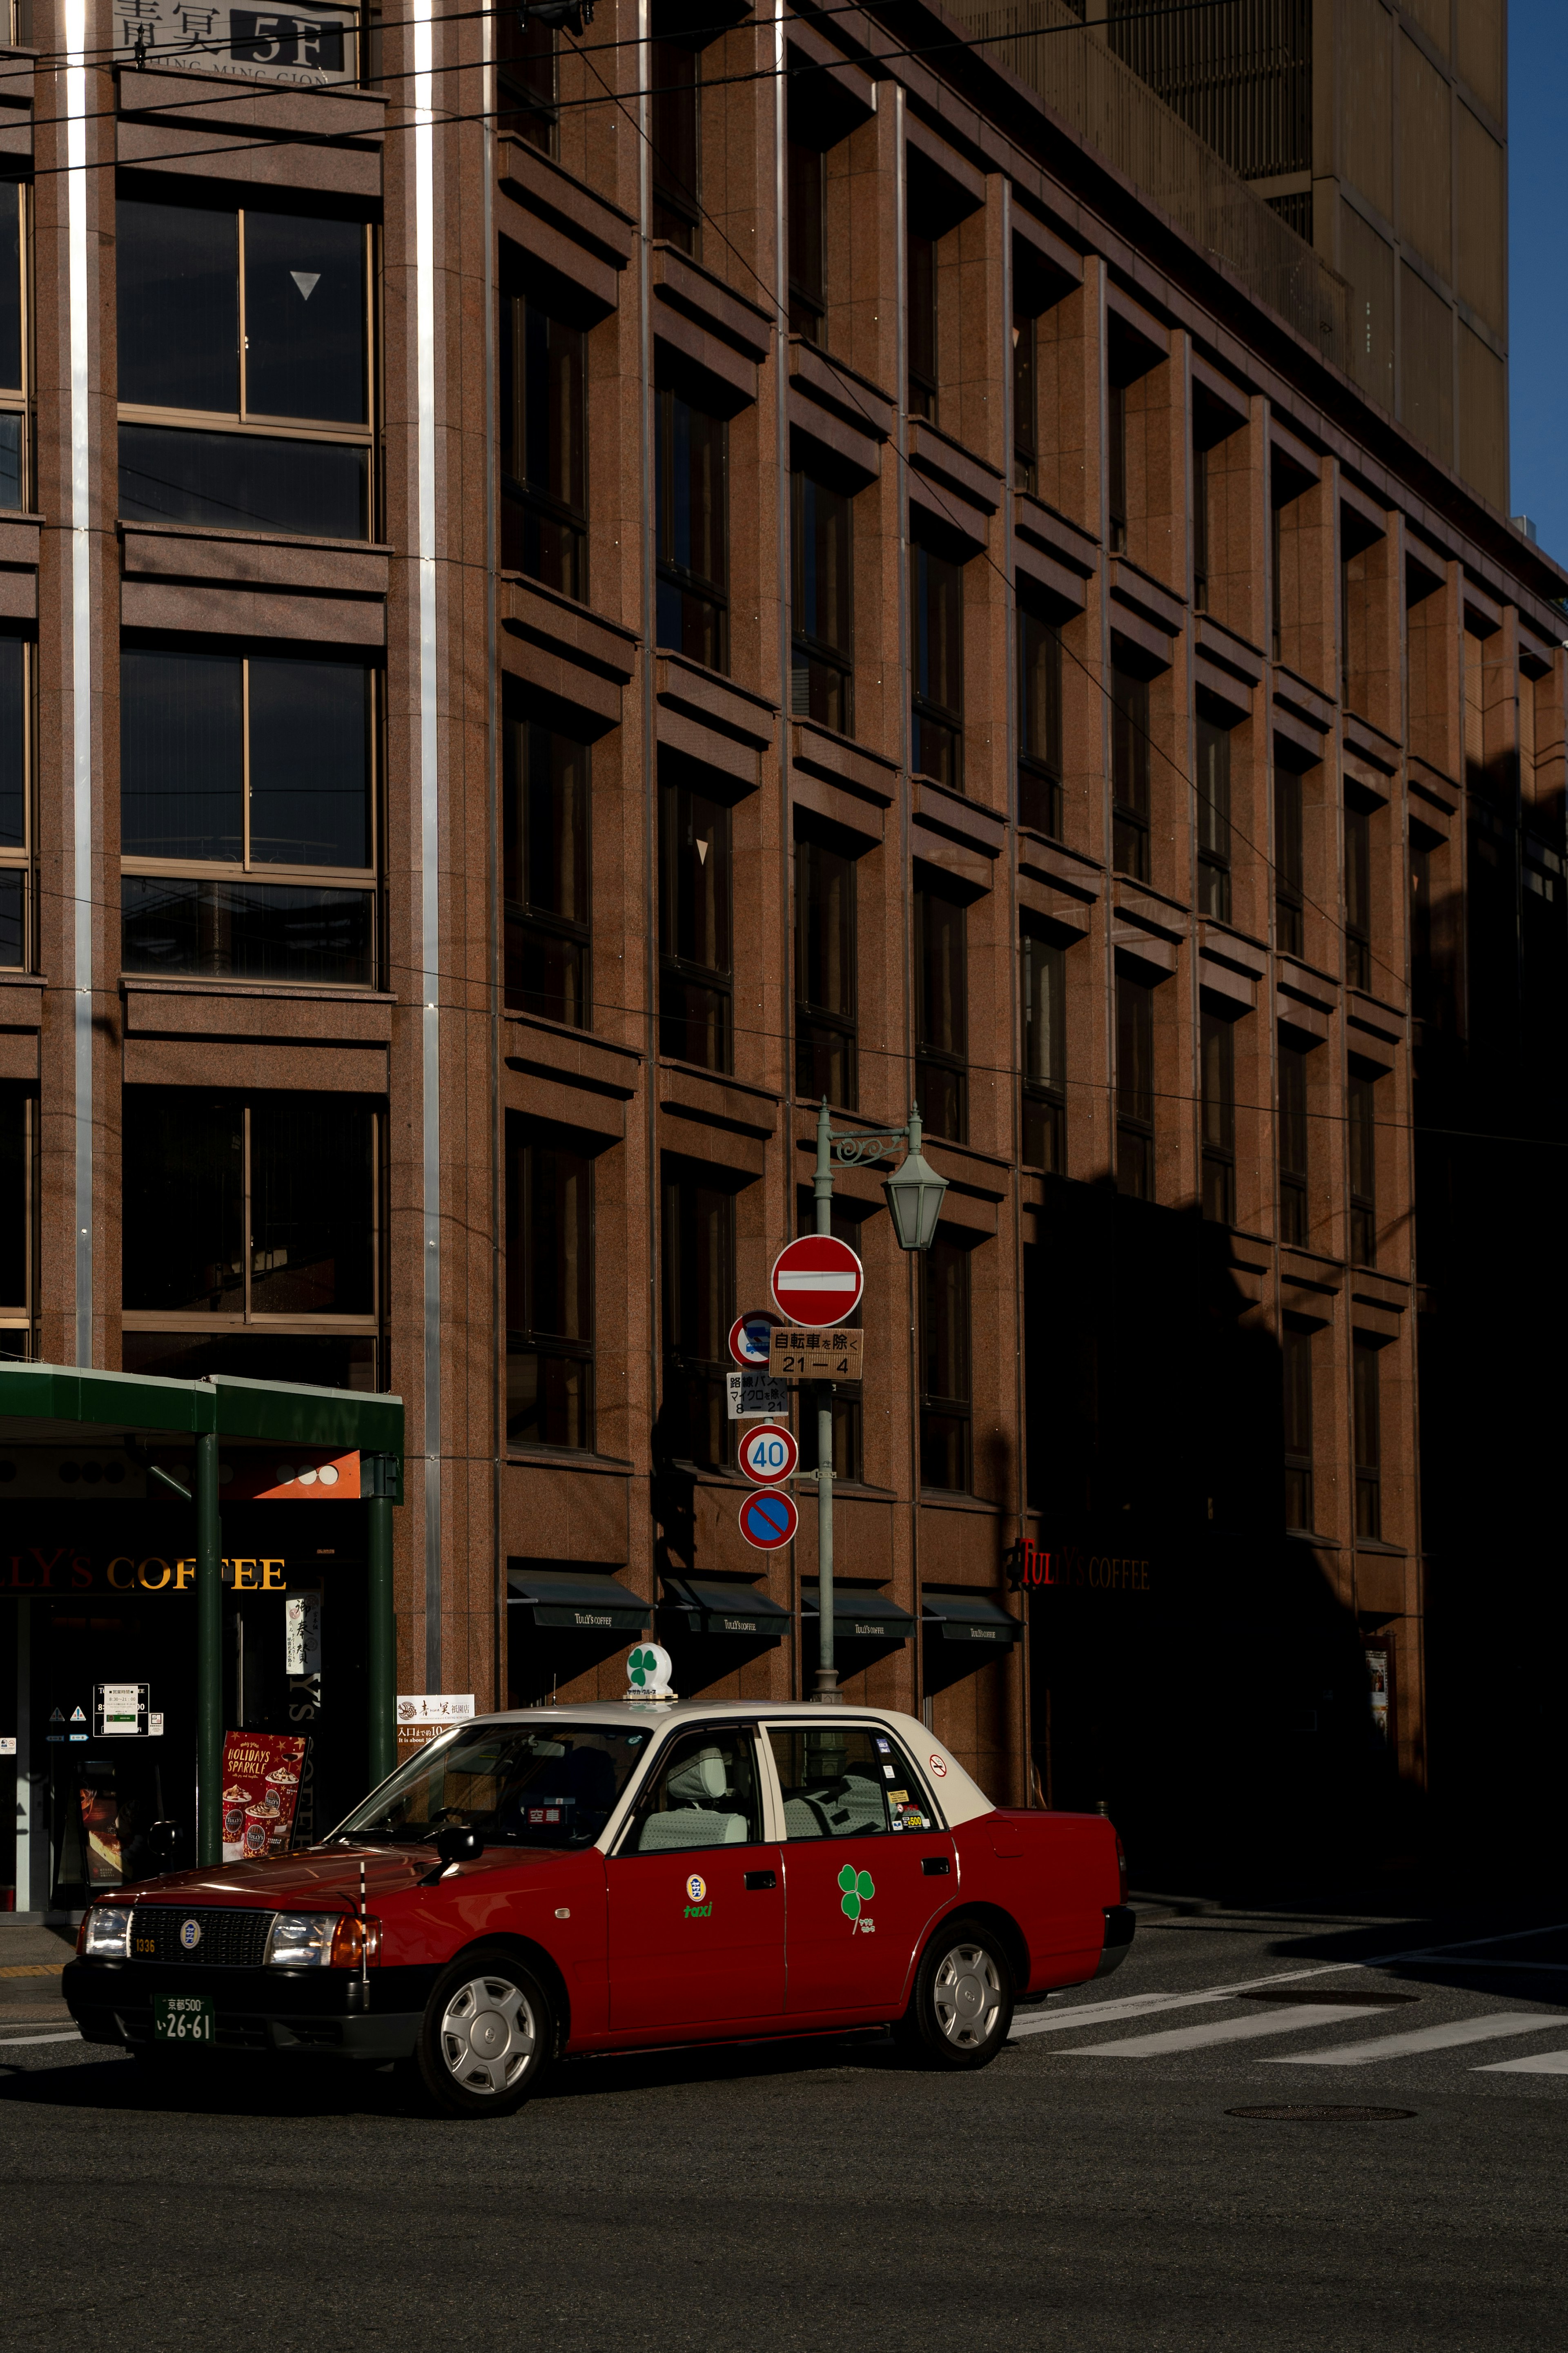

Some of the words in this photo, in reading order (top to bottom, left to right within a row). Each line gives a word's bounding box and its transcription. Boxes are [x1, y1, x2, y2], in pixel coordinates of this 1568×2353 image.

[252, 17, 322, 67] 5F
[149, 56, 202, 70] HING
[775, 1333, 858, 1350] 自転車を除く
[730, 1389, 785, 1401] マイクロを除く
[753, 1442, 783, 1467] 40
[0, 1547, 94, 1588] LY'S
[107, 1557, 286, 1590] COFEE
[1020, 1538, 1085, 1586] TULLY'S
[1089, 1556, 1150, 1590] COFFEE
[575, 1613, 594, 1624] TULLY'S
[724, 1619, 741, 1630] TULLY'S
[741, 1623, 756, 1631] COFFEE
[855, 1624, 870, 1634] TULLY'S
[970, 1628, 983, 1637] TULLY'S
[228, 1749, 270, 1763] HOLIDAYS
[227, 1760, 267, 1775] SPARKLE
[530, 1809, 560, 1822] 空車
[683, 1901, 713, 1918] taxi
[136, 1938, 155, 1953] 1336
[156, 2020, 167, 2031] い
[167, 2013, 209, 2039] 26-61
